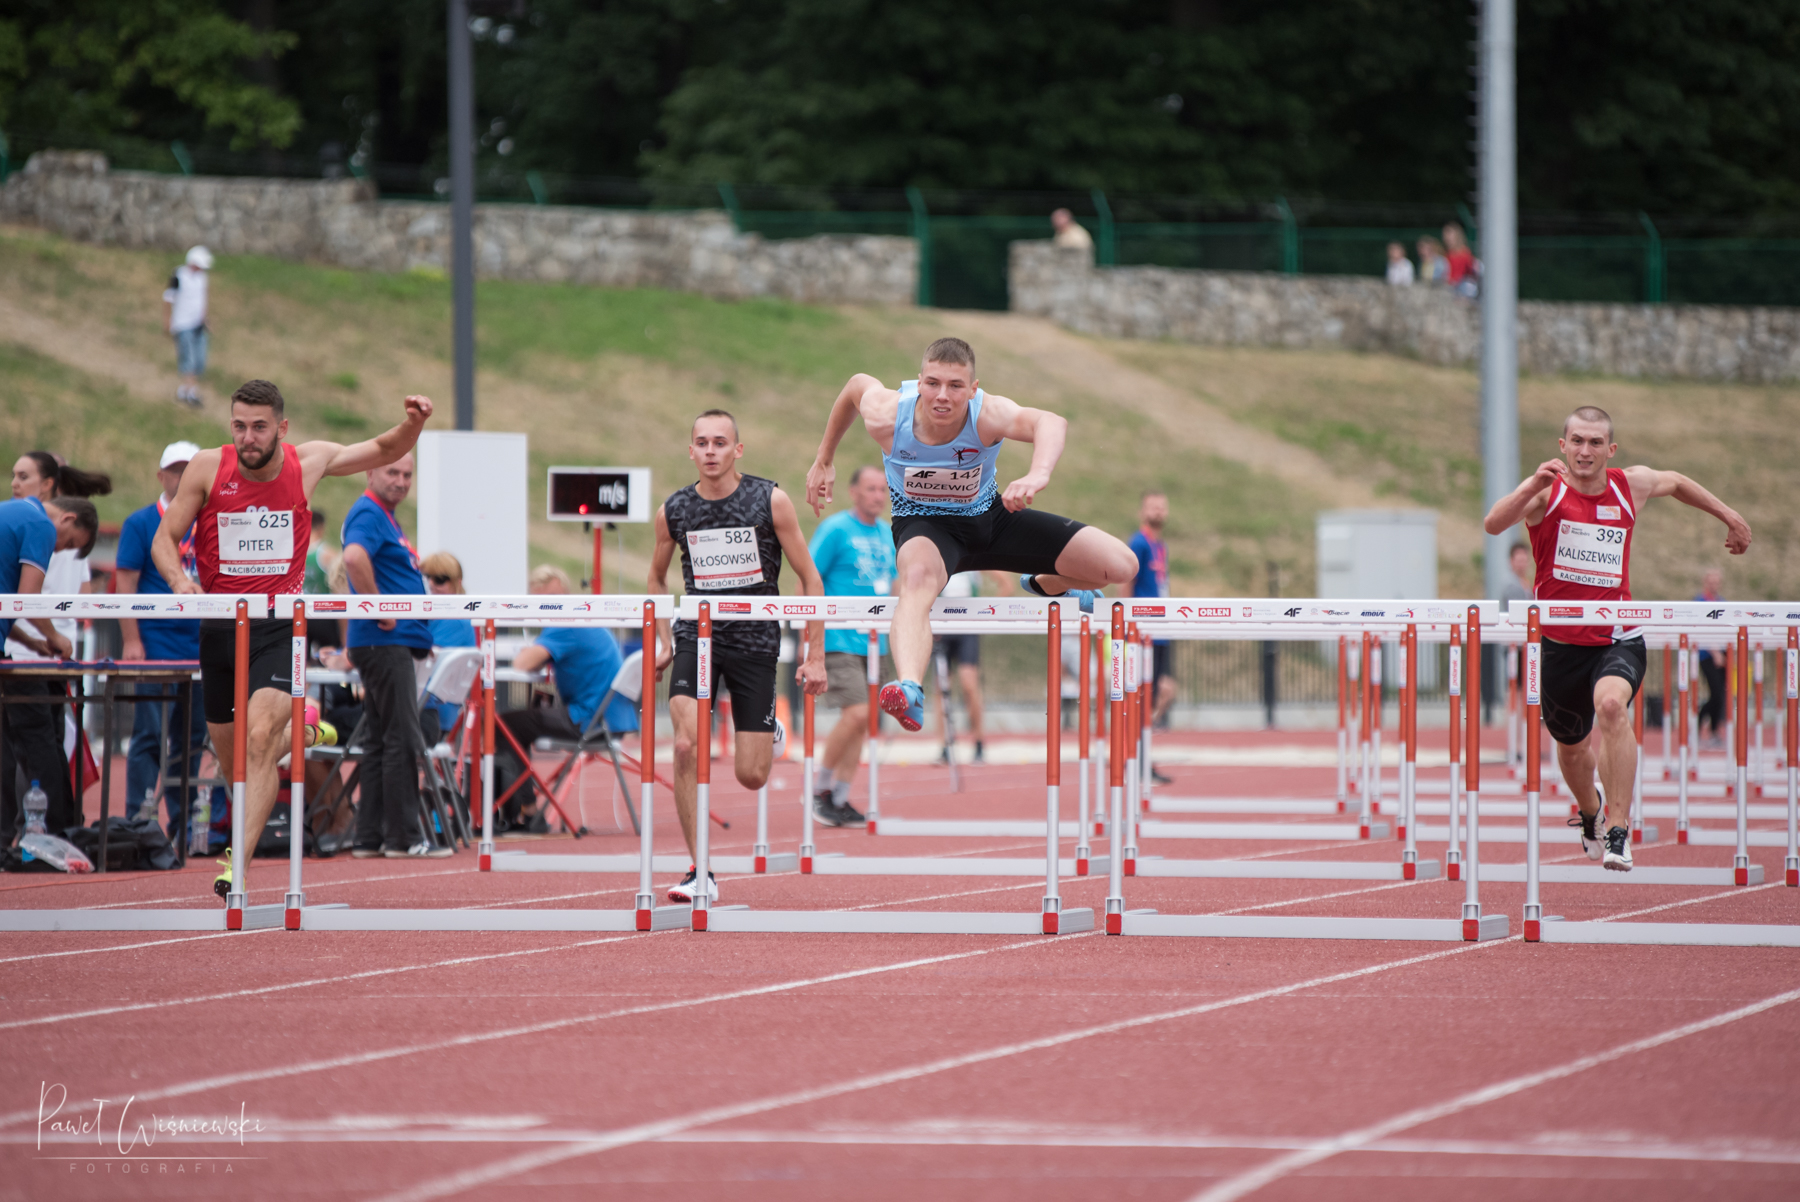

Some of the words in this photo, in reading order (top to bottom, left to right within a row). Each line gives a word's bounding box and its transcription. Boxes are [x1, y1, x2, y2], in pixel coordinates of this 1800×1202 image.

[912, 470, 936, 478] 4F
[950, 467, 980, 480] 142
[906, 480, 980, 492] RADZEWICZ
[599, 480, 627, 510] m/s
[259, 514, 289, 528] 625
[725, 530, 752, 544] 582
[1596, 528, 1623, 544] 393
[239, 540, 274, 551] PITER
[693, 552, 757, 567] KŁOSOWSKI
[1558, 546, 1621, 566] KALISZEWSKI
[228, 565, 265, 574] RACIBÓRZ
[702, 579, 736, 587] RACIBÓRZ
[738, 577, 754, 585] 2019
[1560, 572, 1596, 583] RACIBÓRZ
[55, 601, 73, 611] 4F
[464, 602, 482, 611] 4F
[868, 605, 886, 614] 4F
[1284, 608, 1302, 617] 4F
[1706, 610, 1725, 619] 4F
[294, 653, 302, 686] polanik
[699, 654, 707, 687] polanik
[1112, 656, 1121, 689] polanik
[1529, 659, 1538, 693] polanik
